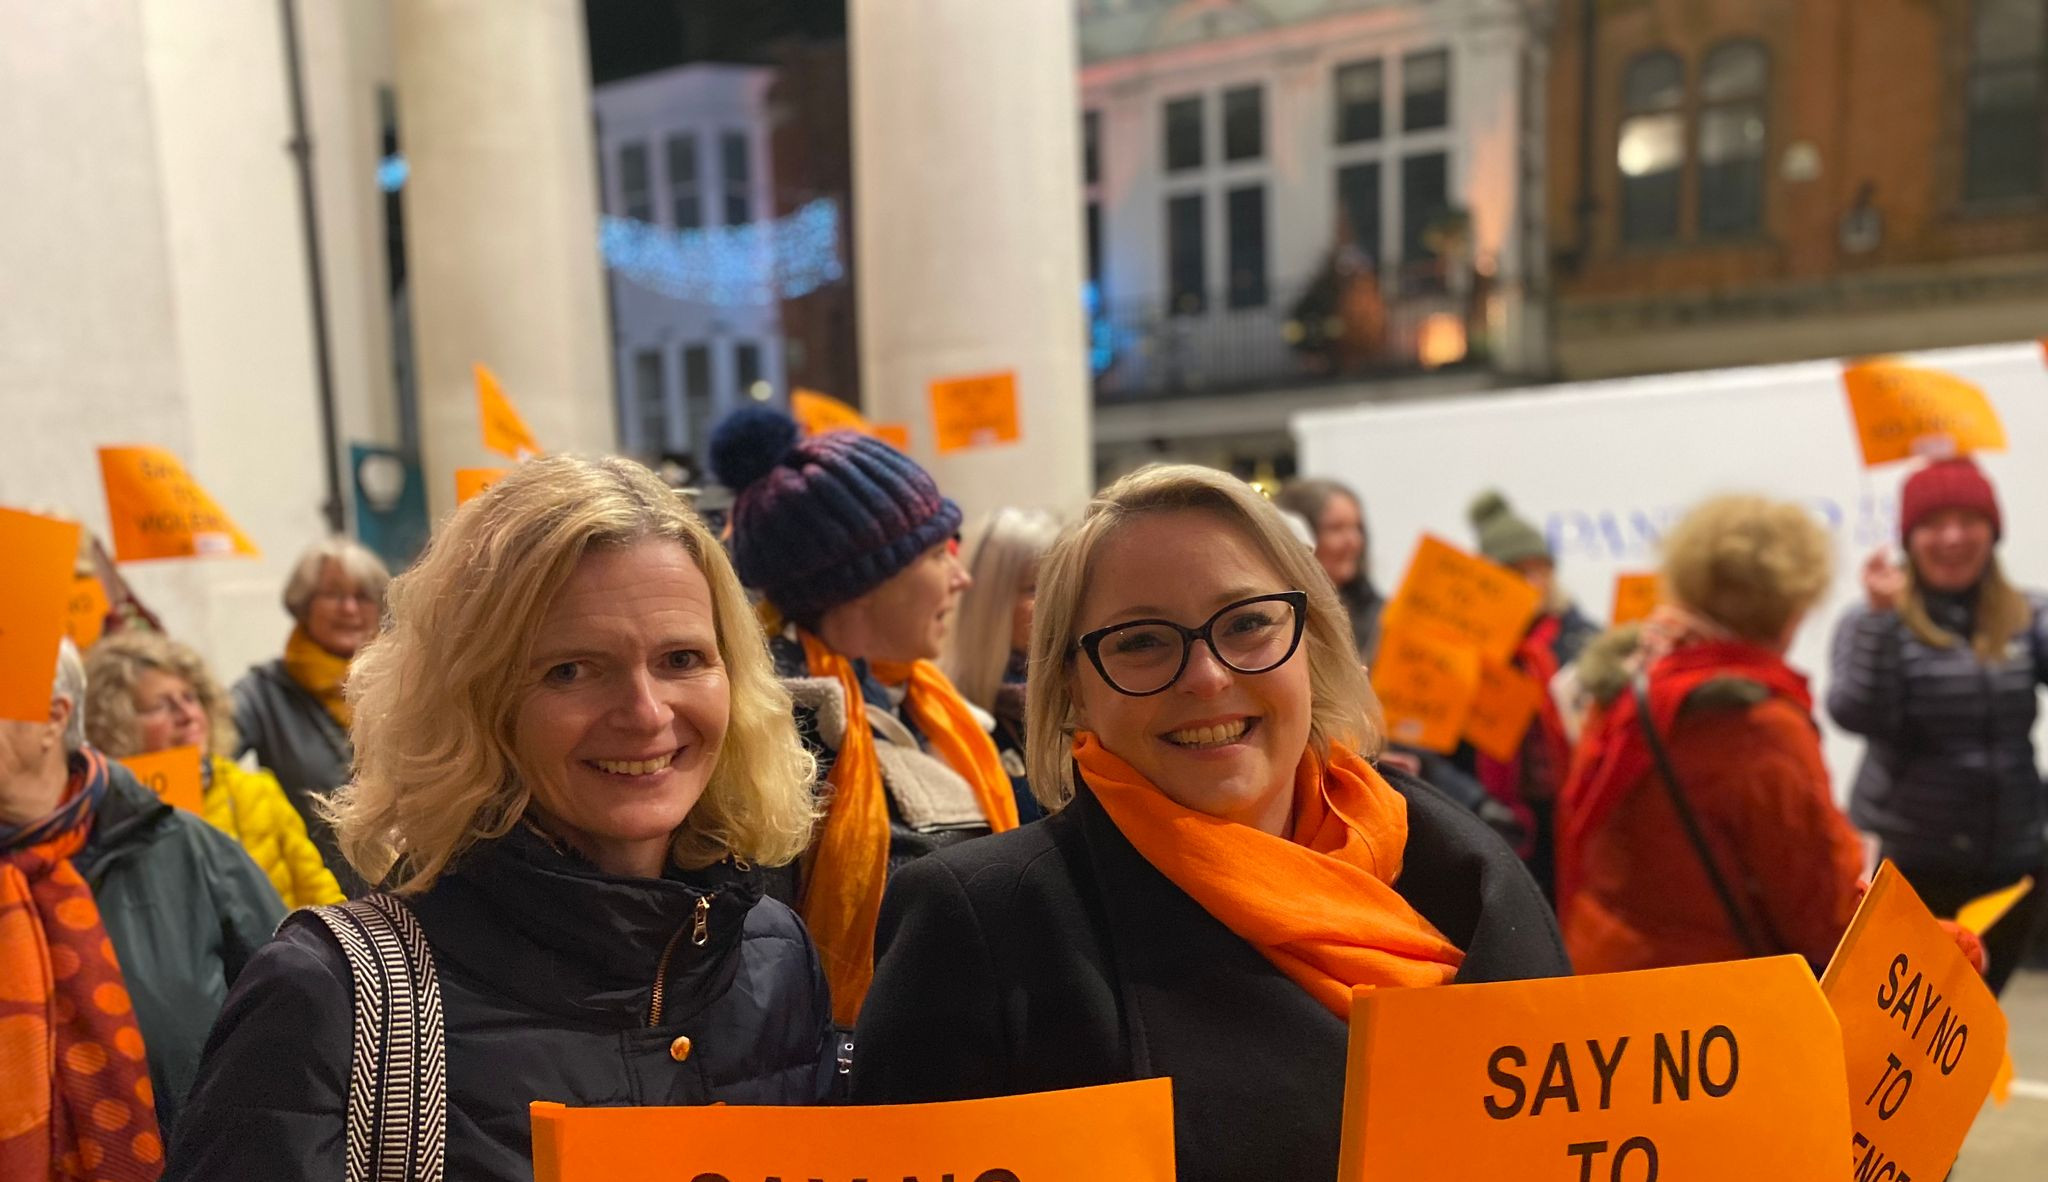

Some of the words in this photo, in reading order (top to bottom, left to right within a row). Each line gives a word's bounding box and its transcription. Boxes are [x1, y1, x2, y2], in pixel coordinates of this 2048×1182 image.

[1877, 953, 1942, 1040] SAY
[1926, 1007, 1968, 1075] NO
[1483, 1036, 1630, 1120] SAY
[1652, 1024, 1739, 1104] NO
[1865, 1053, 1912, 1120] TO
